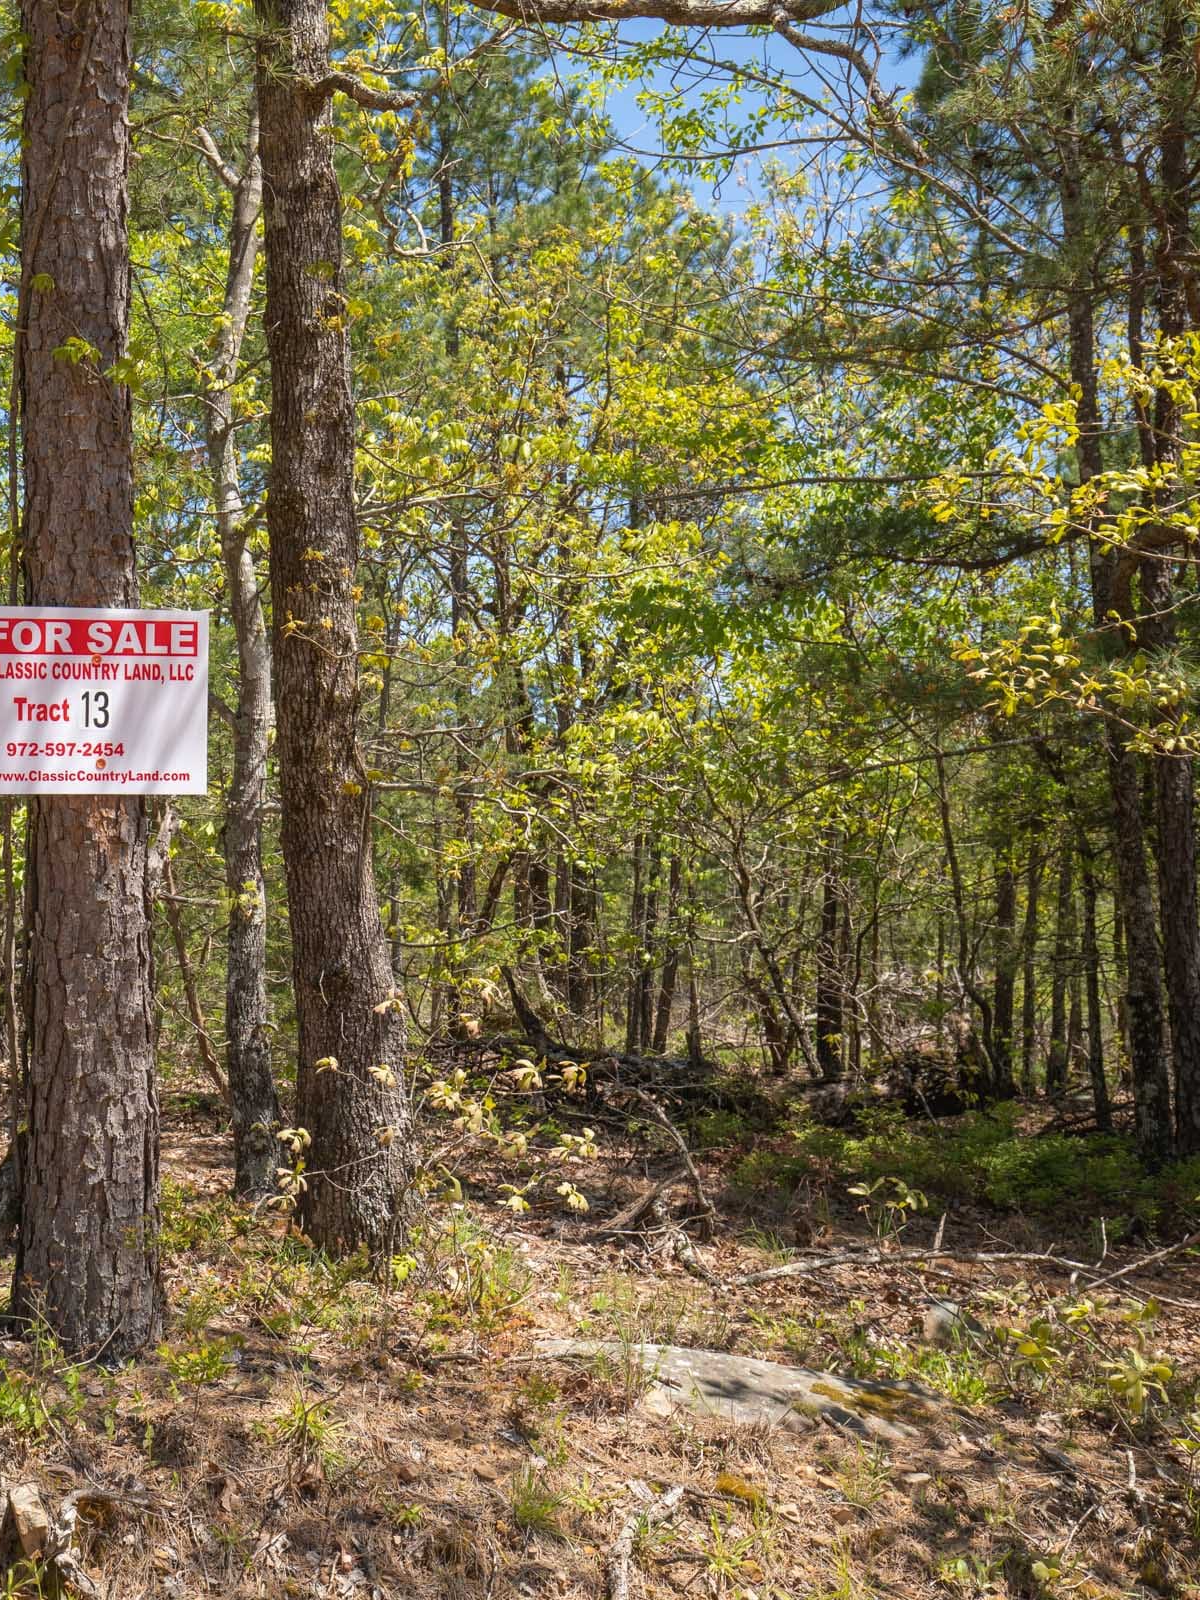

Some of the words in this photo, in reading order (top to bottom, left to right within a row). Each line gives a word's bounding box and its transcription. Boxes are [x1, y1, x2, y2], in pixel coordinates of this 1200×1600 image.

[87, 621, 195, 655] SALE
[52, 662, 119, 681] COUNTRY
[124, 663, 164, 685] LAND,
[169, 664, 194, 681] LLC
[13, 697, 70, 722] Tract
[81, 691, 110, 728] 13
[6, 742, 125, 757] 972-597-2454
